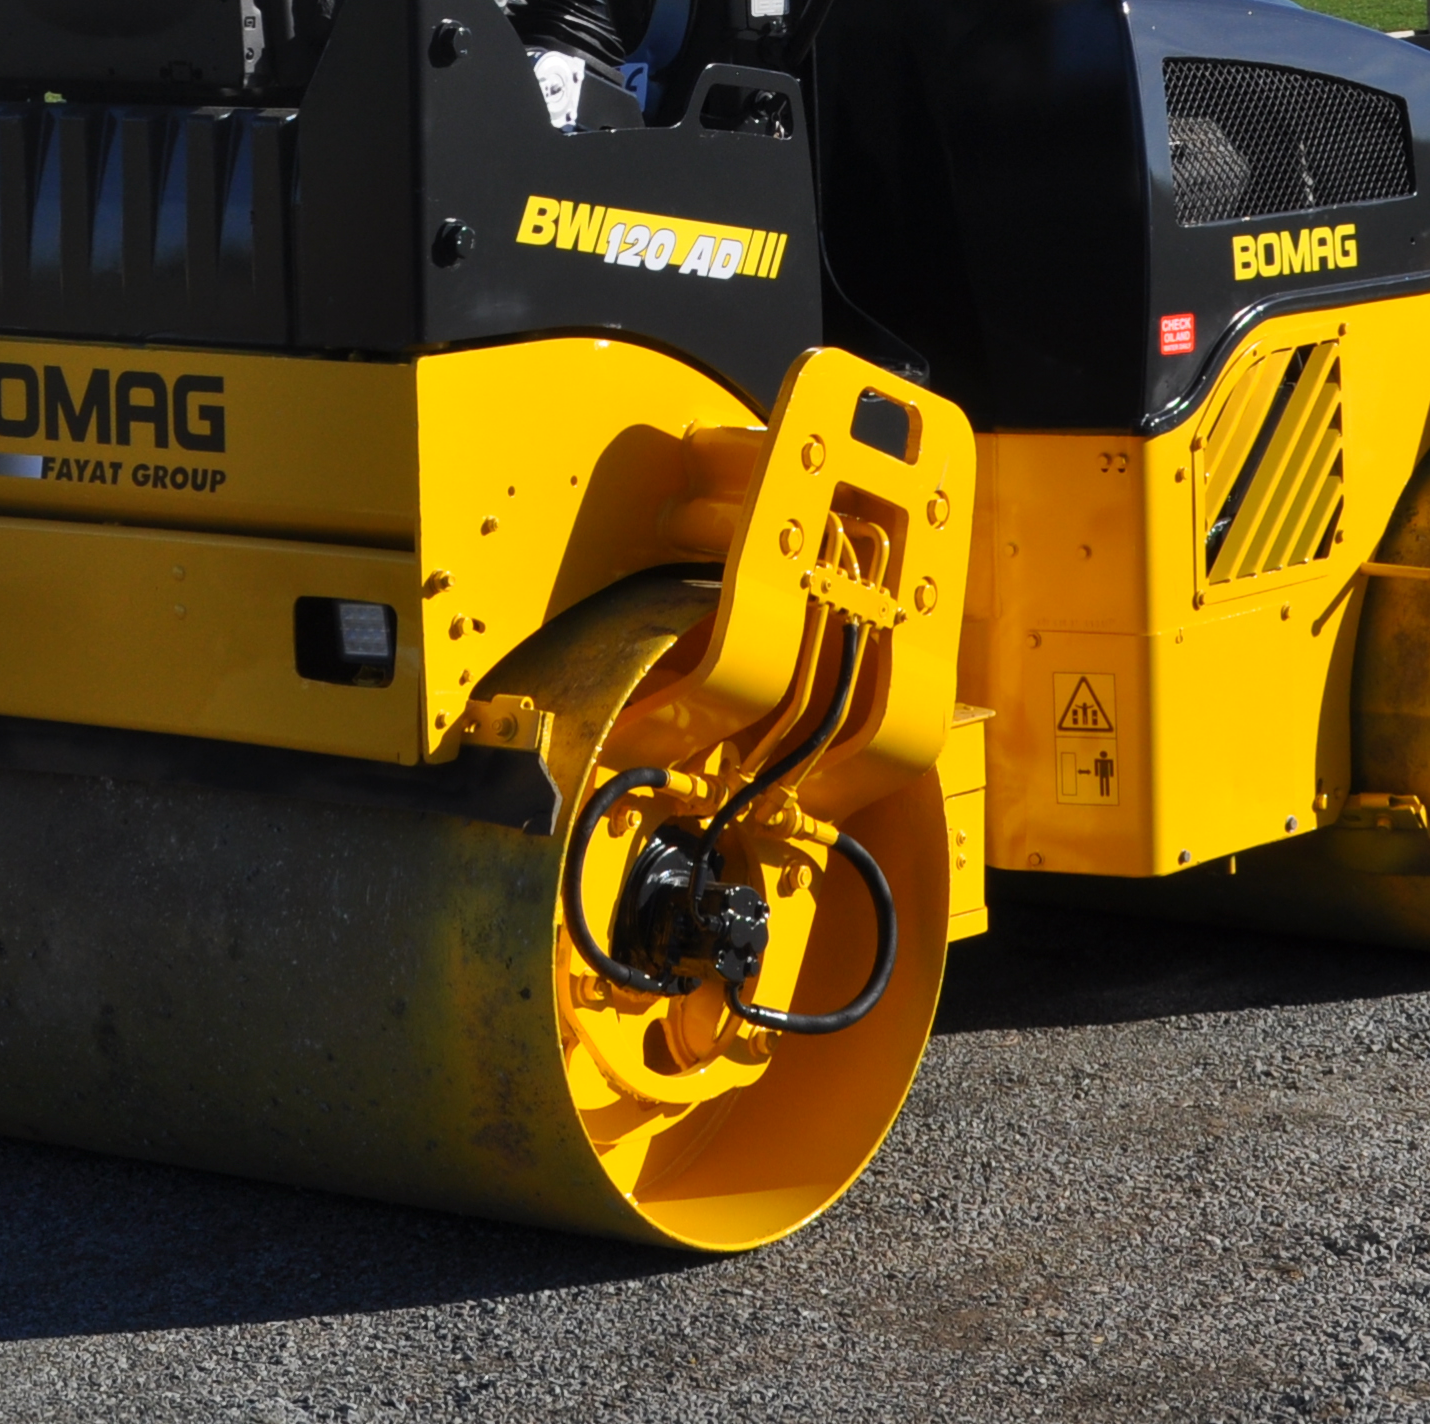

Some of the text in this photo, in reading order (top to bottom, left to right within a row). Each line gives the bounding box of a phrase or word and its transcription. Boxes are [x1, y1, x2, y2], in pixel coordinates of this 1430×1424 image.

[604, 222, 677, 271] 120
[1232, 223, 1358, 281] BOMAG
[1161, 317, 1192, 332] CHECK
[42, 456, 226, 493] FAYAT GROUP
